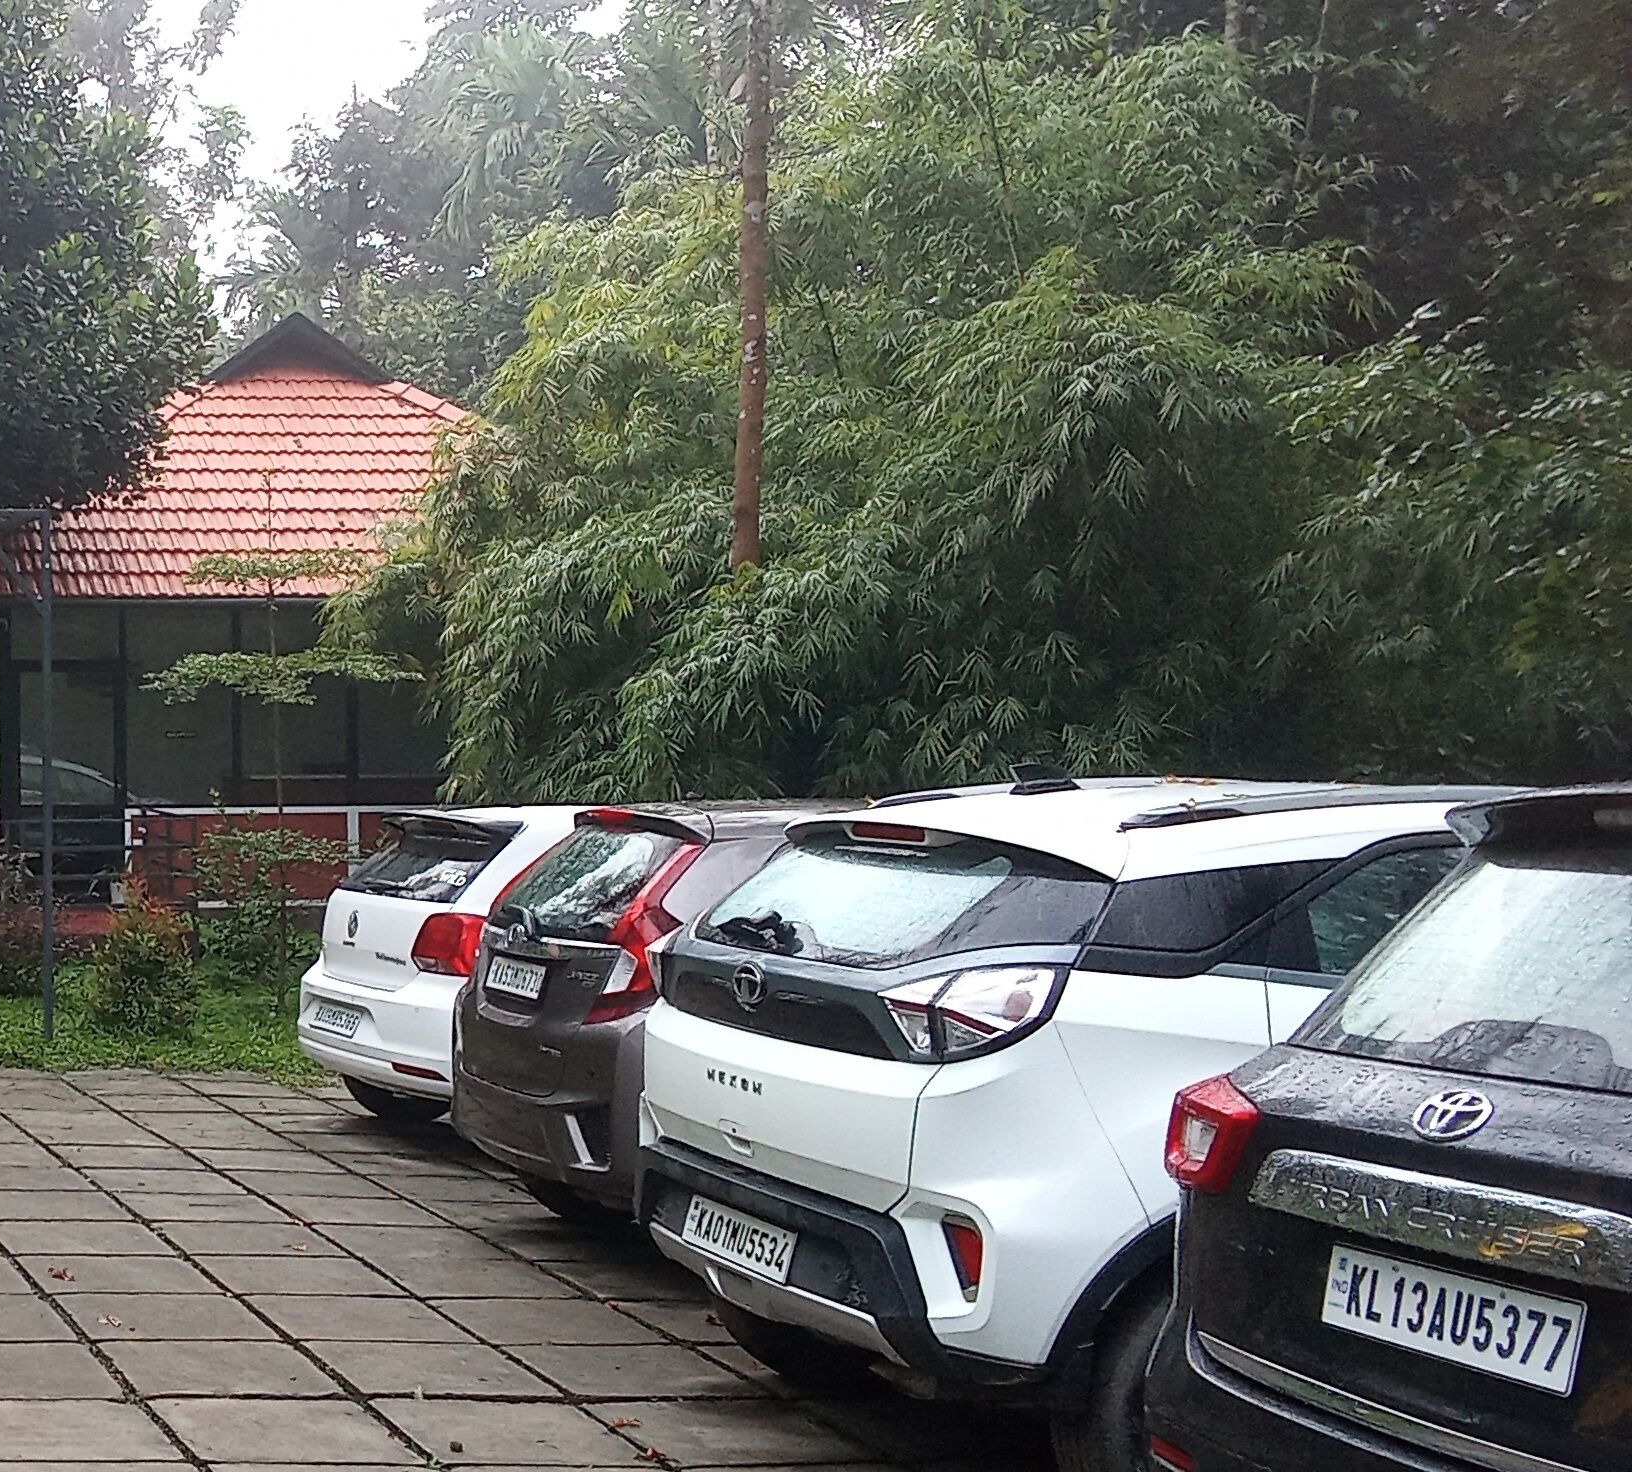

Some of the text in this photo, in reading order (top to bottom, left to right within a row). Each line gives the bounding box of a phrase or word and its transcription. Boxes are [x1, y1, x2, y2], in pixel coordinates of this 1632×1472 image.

[707, 1067, 762, 1096] NEXON
[694, 1206, 789, 1273] KA01MU5534
[1345, 1263, 1573, 1373] KL13AU5377
